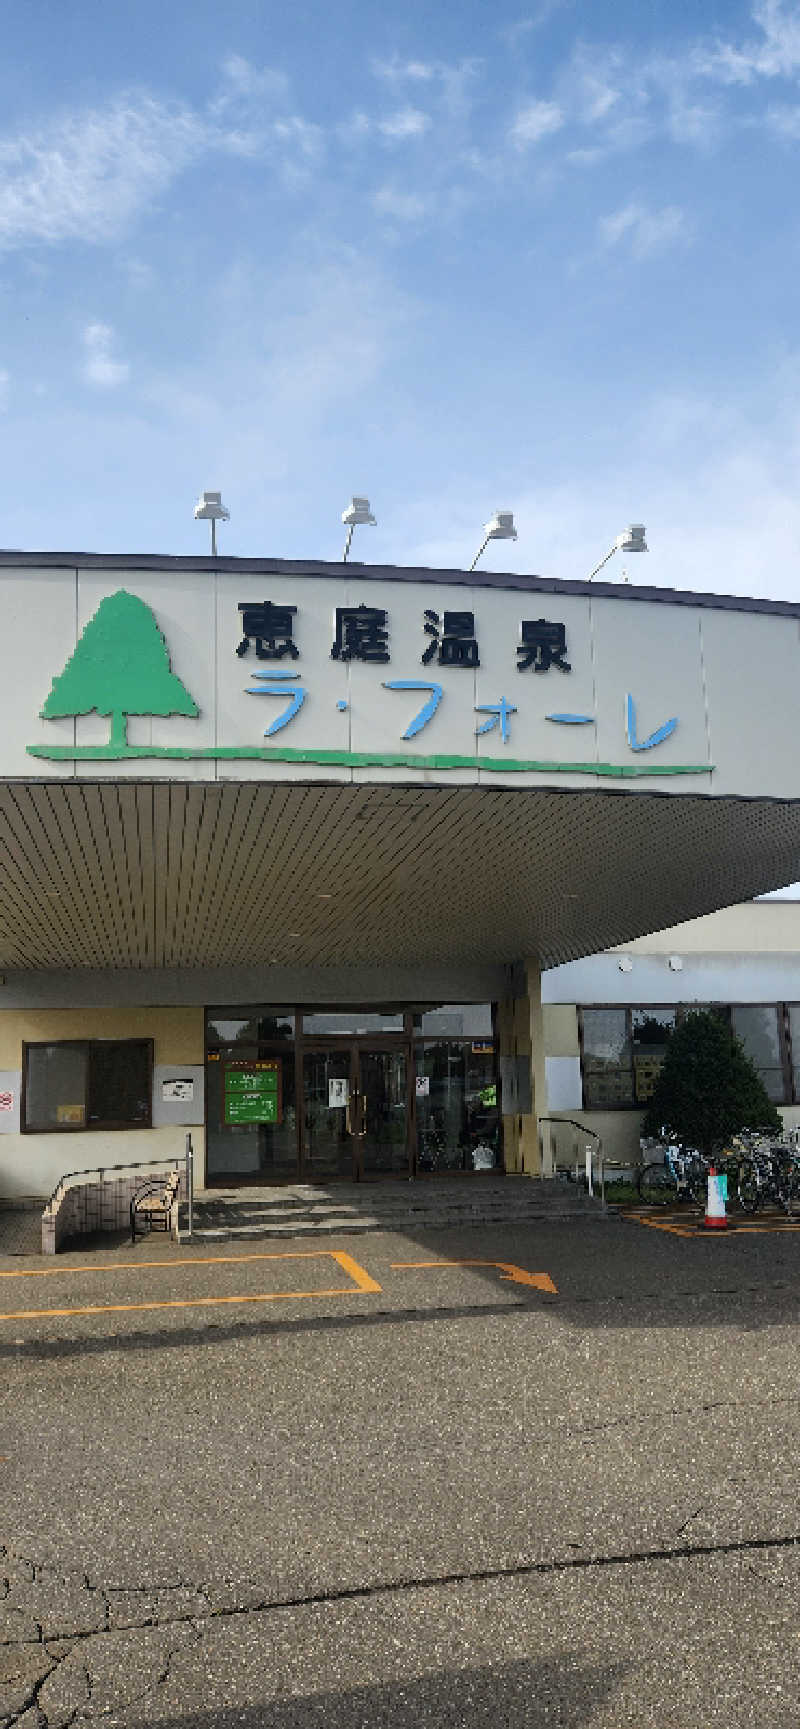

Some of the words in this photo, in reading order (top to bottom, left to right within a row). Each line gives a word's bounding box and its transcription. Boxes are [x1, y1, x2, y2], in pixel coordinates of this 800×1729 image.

[236, 601, 572, 673] 恵庭温泉
[244, 670, 679, 753] ラ・フォーレ
